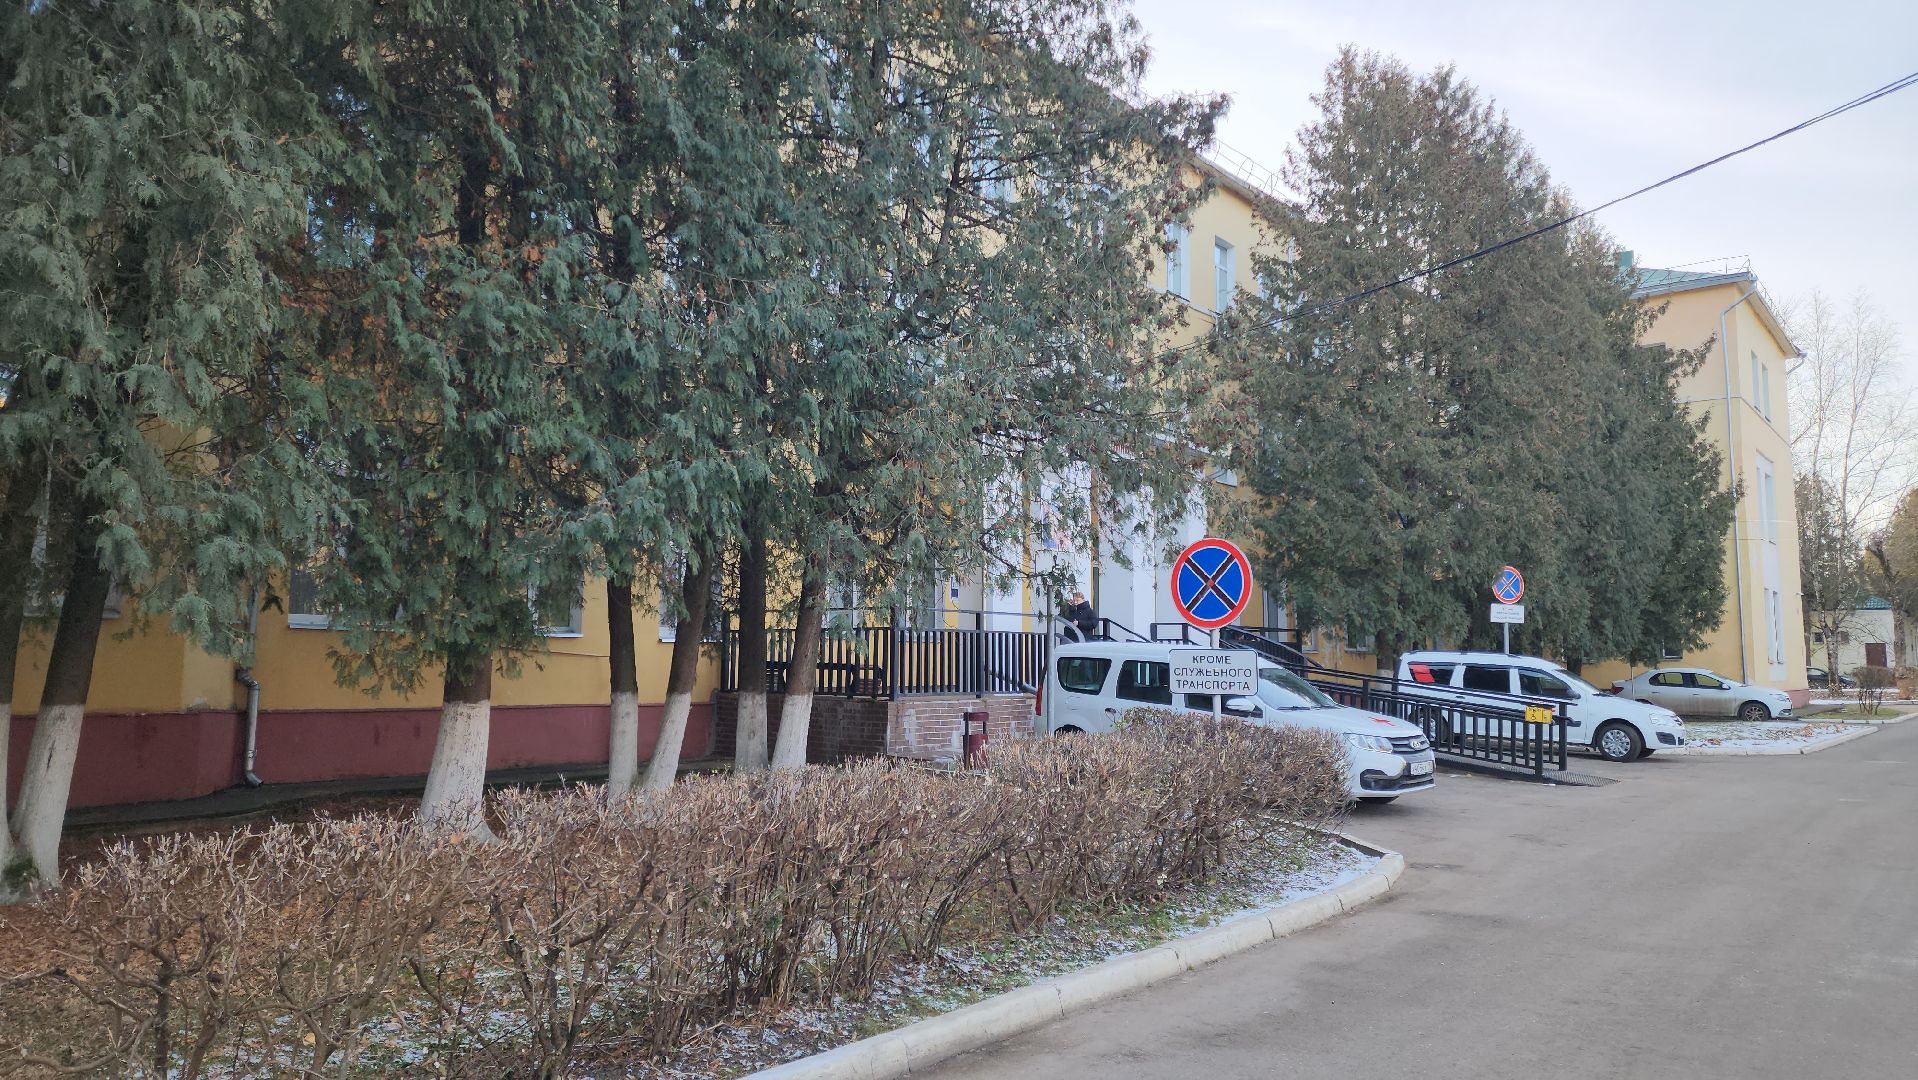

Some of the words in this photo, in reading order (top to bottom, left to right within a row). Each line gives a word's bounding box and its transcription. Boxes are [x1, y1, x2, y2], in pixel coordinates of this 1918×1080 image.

[1192, 655, 1231, 664] КРОМЕ
[1173, 667, 1252, 678] СЛУЖЕБНОГО
[1175, 679, 1251, 691] ТРАНСПОРТА
